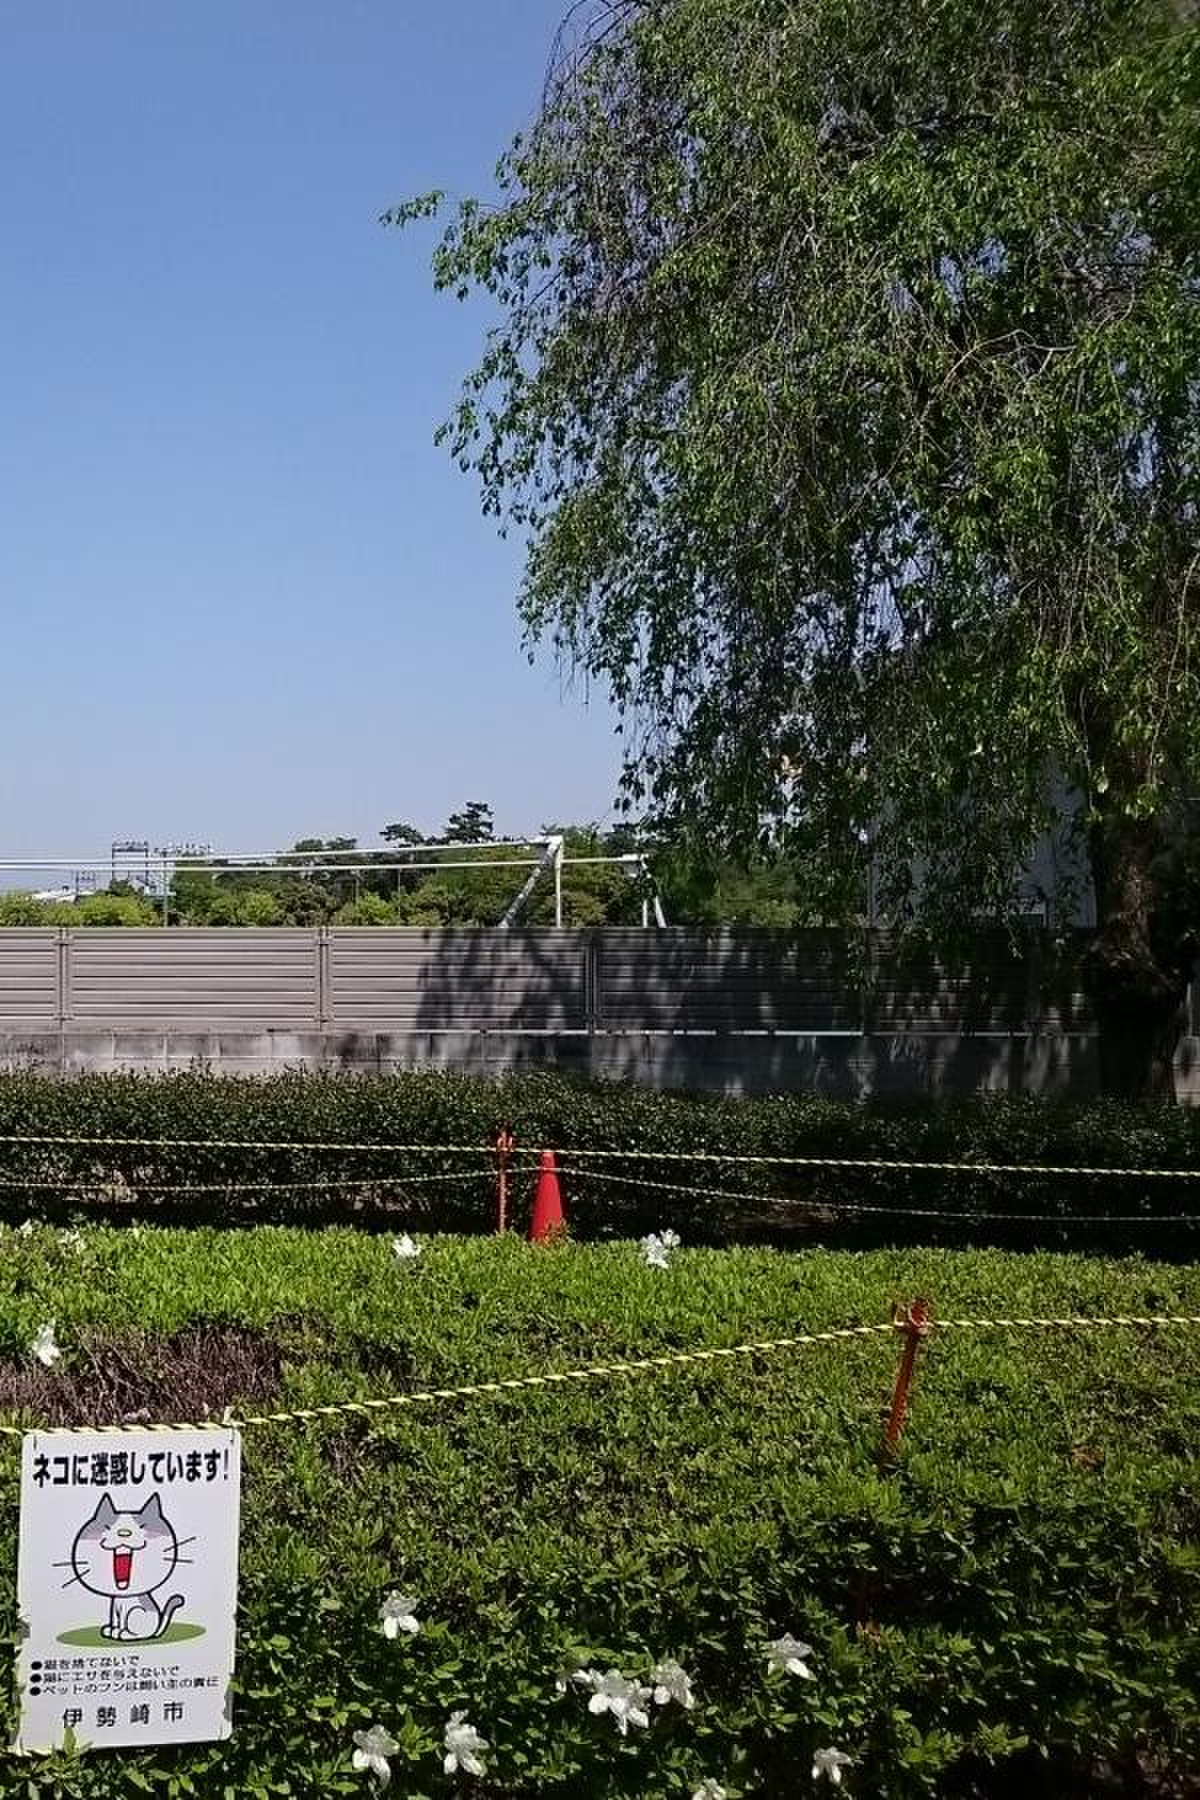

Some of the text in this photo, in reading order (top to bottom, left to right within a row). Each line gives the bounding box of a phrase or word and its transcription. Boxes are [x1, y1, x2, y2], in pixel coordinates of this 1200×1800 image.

[32, 1449, 230, 1488] ネコに迷惑しています!
[62, 1702, 185, 1729] 伊勢崎市
